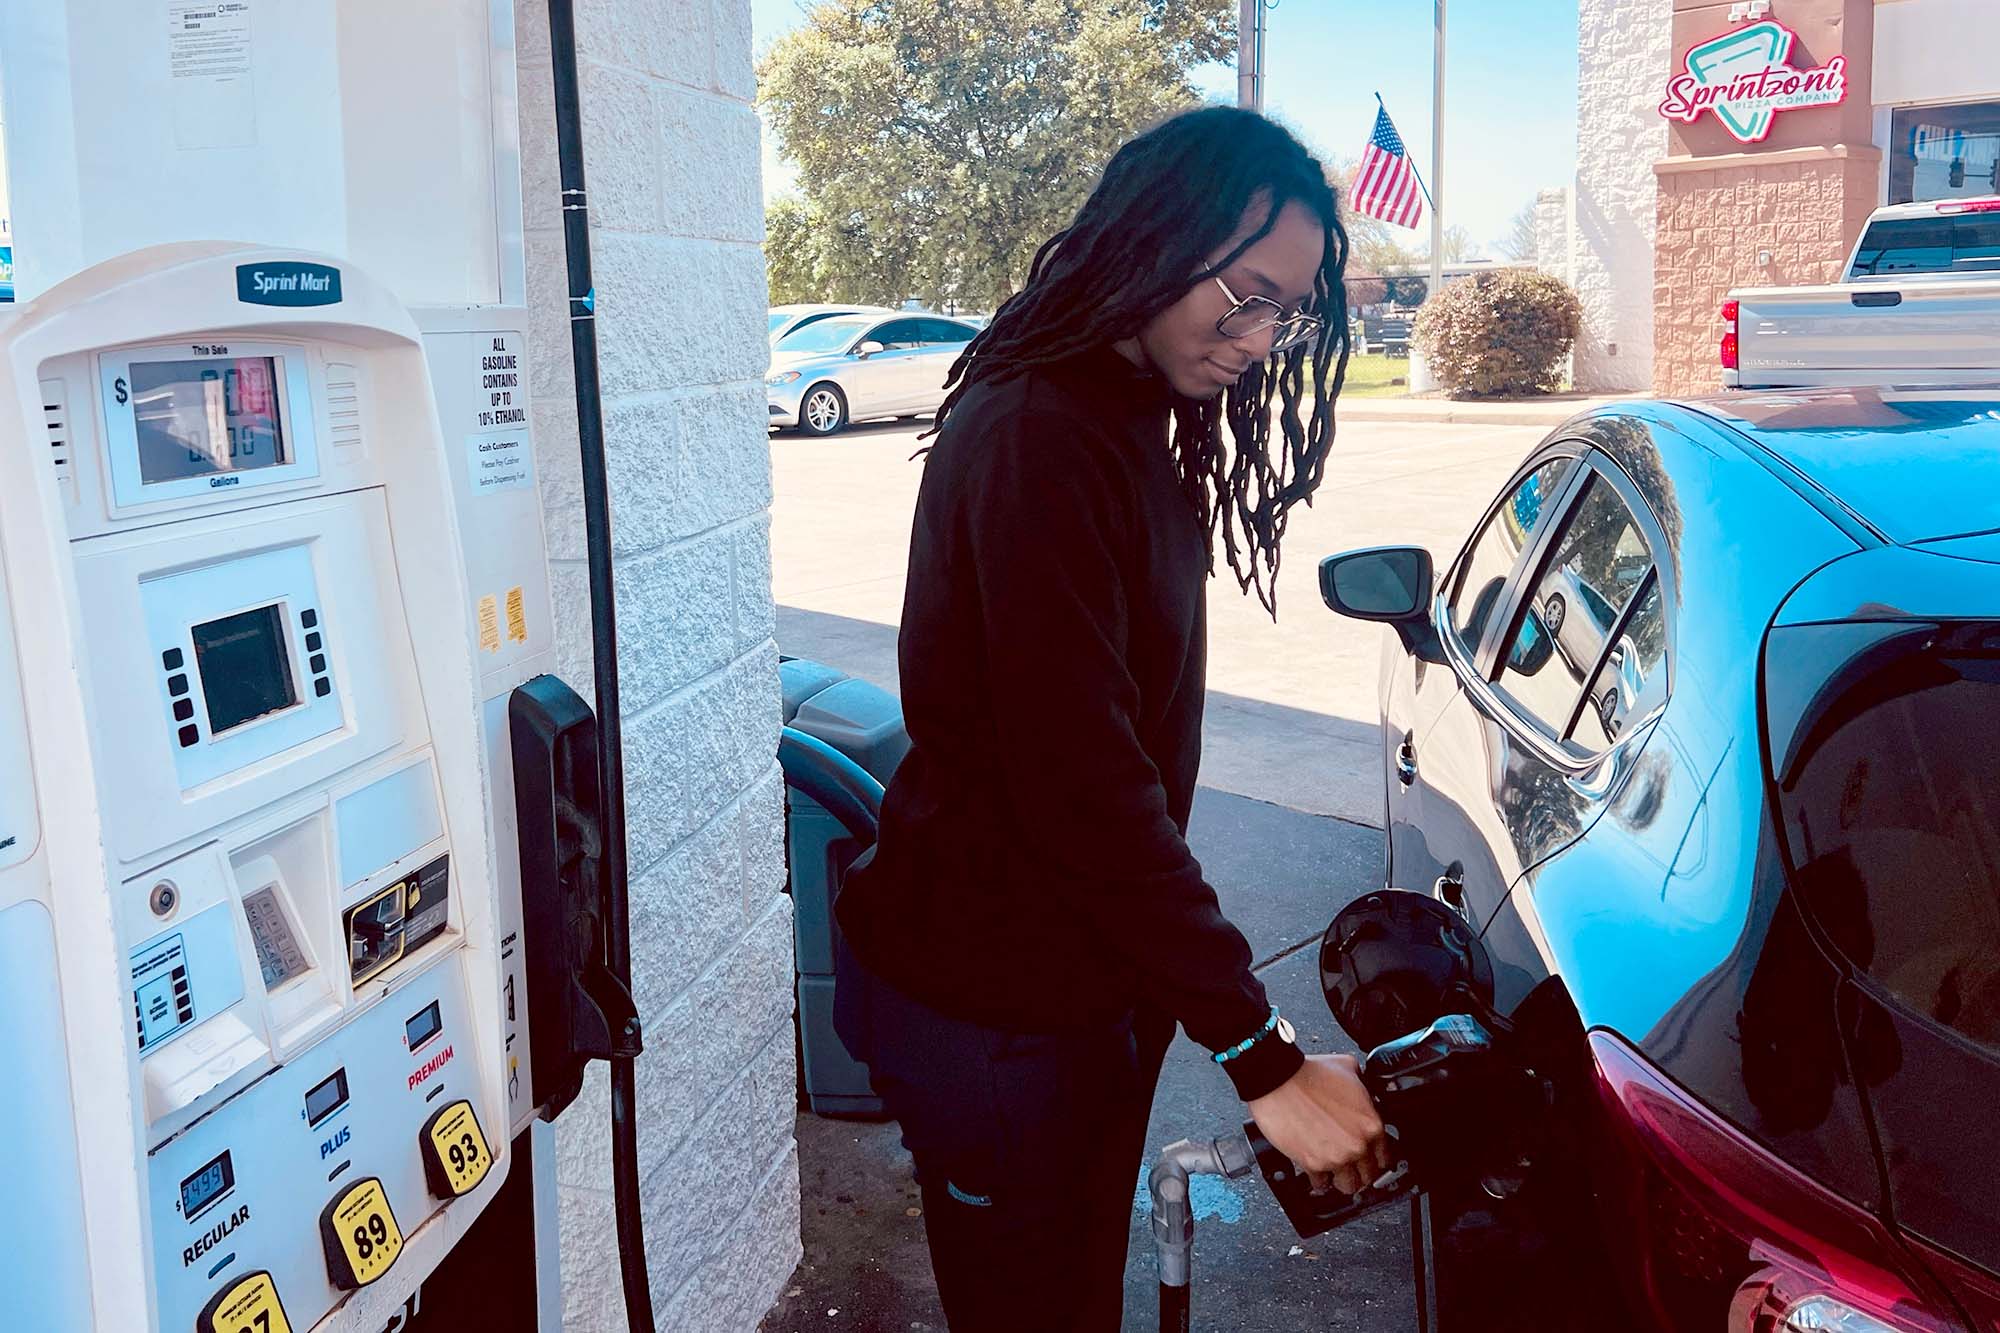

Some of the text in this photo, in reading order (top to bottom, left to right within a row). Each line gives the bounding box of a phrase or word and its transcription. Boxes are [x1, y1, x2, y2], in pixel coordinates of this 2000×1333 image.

[1664, 62, 1840, 117] Sprintzoni
[1735, 92, 1841, 110] PIZZA COMPANY
[254, 272, 330, 295] Sprint Mart
[192, 345, 228, 356] This Sale
[493, 338, 505, 351] ALL
[482, 355, 517, 370] GASOLINE
[483, 373, 517, 389] CONTAINS
[114, 377, 128, 406] $
[491, 392, 511, 406] UP TO
[478, 408, 525, 426] 10% ETHANOL
[479, 442, 518, 452] Cash Customers
[210, 477, 239, 488] Gallons
[408, 1044, 454, 1091] PREMIUM
[320, 1126, 350, 1160] PLUS
[449, 1133, 478, 1173] 93
[183, 1204, 250, 1268] REGULAR
[354, 1213, 387, 1259] 89
